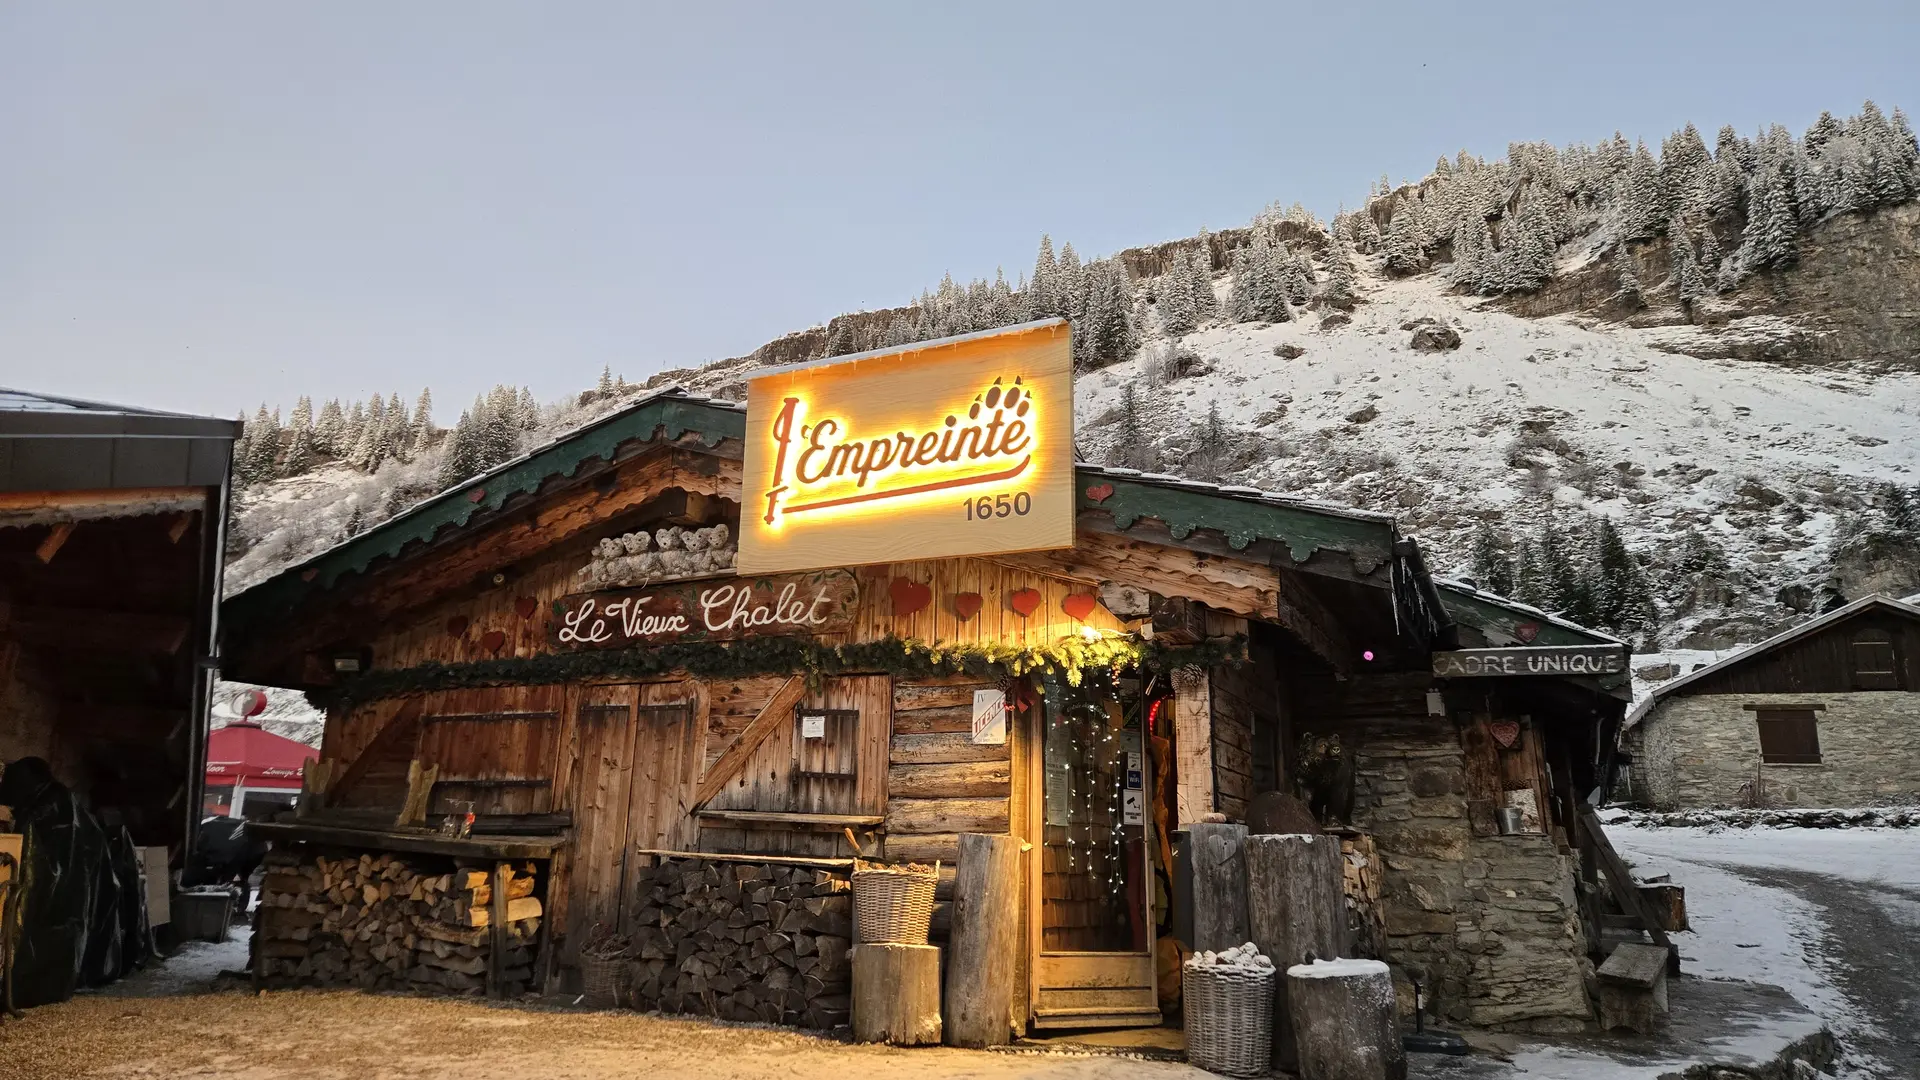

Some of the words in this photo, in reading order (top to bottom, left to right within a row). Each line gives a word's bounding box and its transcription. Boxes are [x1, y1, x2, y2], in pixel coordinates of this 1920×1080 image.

[963, 492, 1032, 521] 1650
[558, 598, 613, 643] Le
[605, 596, 690, 638] Vieux
[701, 582, 831, 632] Chalet
[1433, 655, 1517, 675] CADRE
[1527, 653, 1620, 674] UNIQUE
